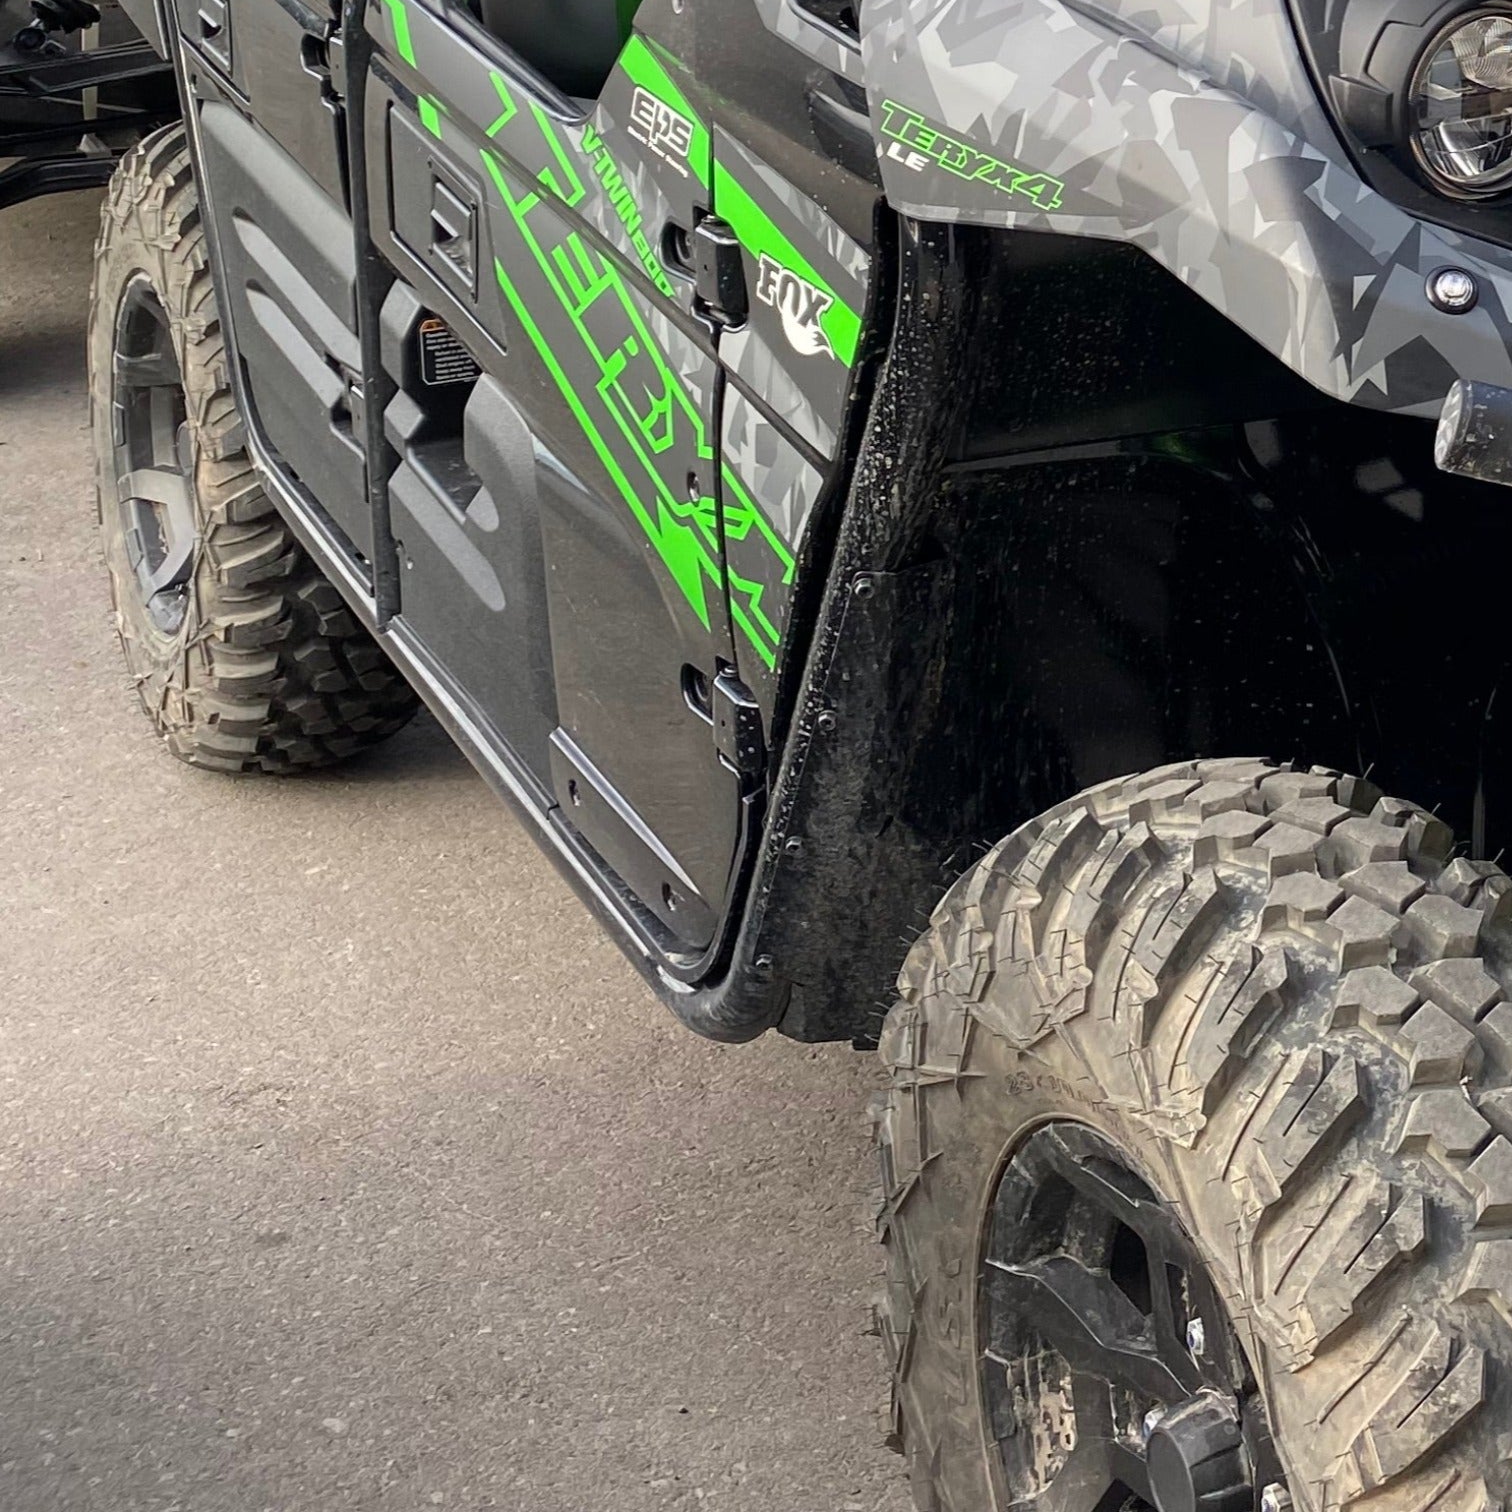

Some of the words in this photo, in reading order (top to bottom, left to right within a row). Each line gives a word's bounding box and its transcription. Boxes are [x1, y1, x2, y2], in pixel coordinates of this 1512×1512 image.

[630, 86, 695, 157] EPS
[880, 98, 1066, 211] TERYX4
[886, 141, 930, 172] LE
[580, 123, 643, 236] V-TWIN
[756, 252, 835, 330] FOX
